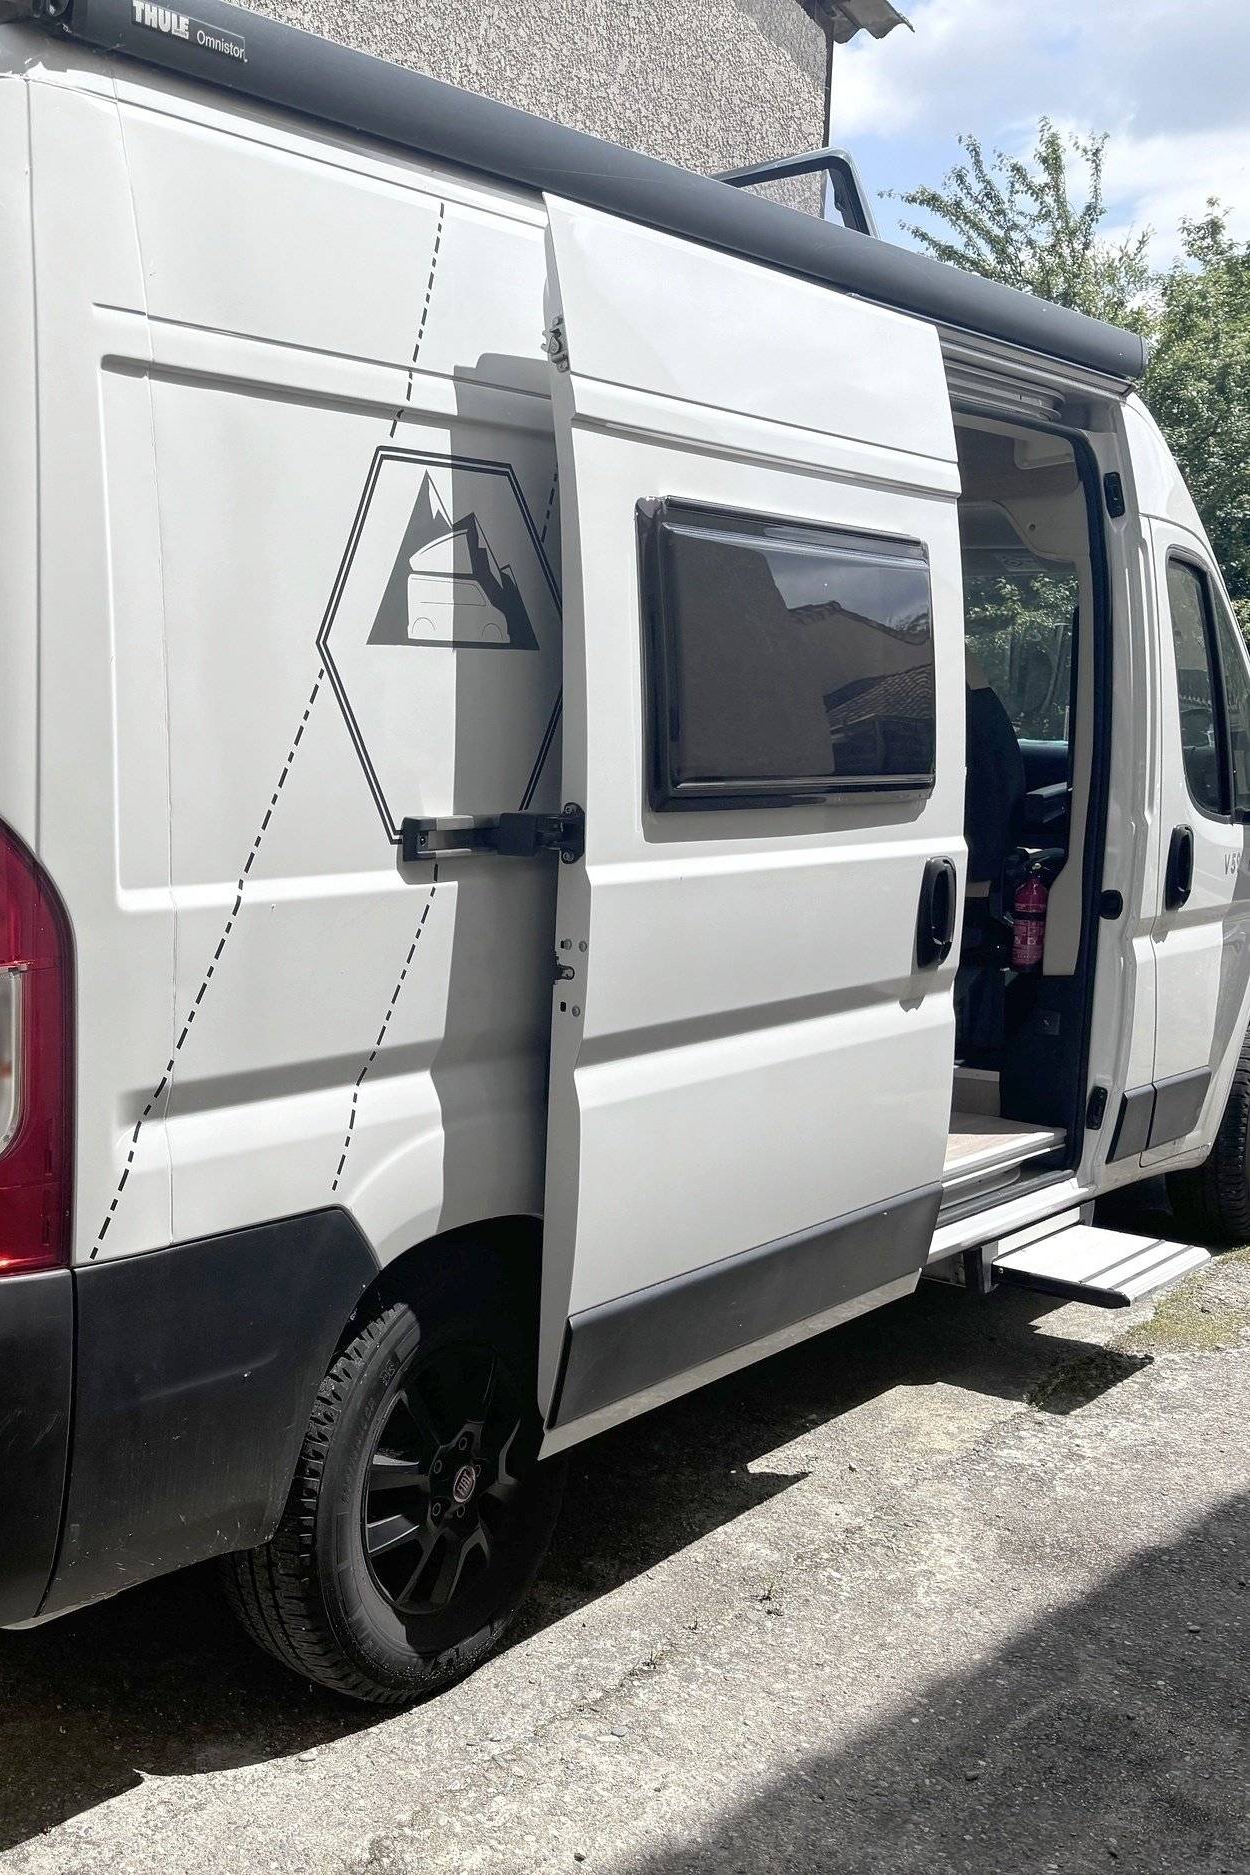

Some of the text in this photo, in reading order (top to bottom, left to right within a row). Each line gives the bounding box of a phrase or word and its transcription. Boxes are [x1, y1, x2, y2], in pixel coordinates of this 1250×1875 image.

[133, 0, 245, 59] THULE Omnistor
[456, 1470, 471, 1496] FIAT
